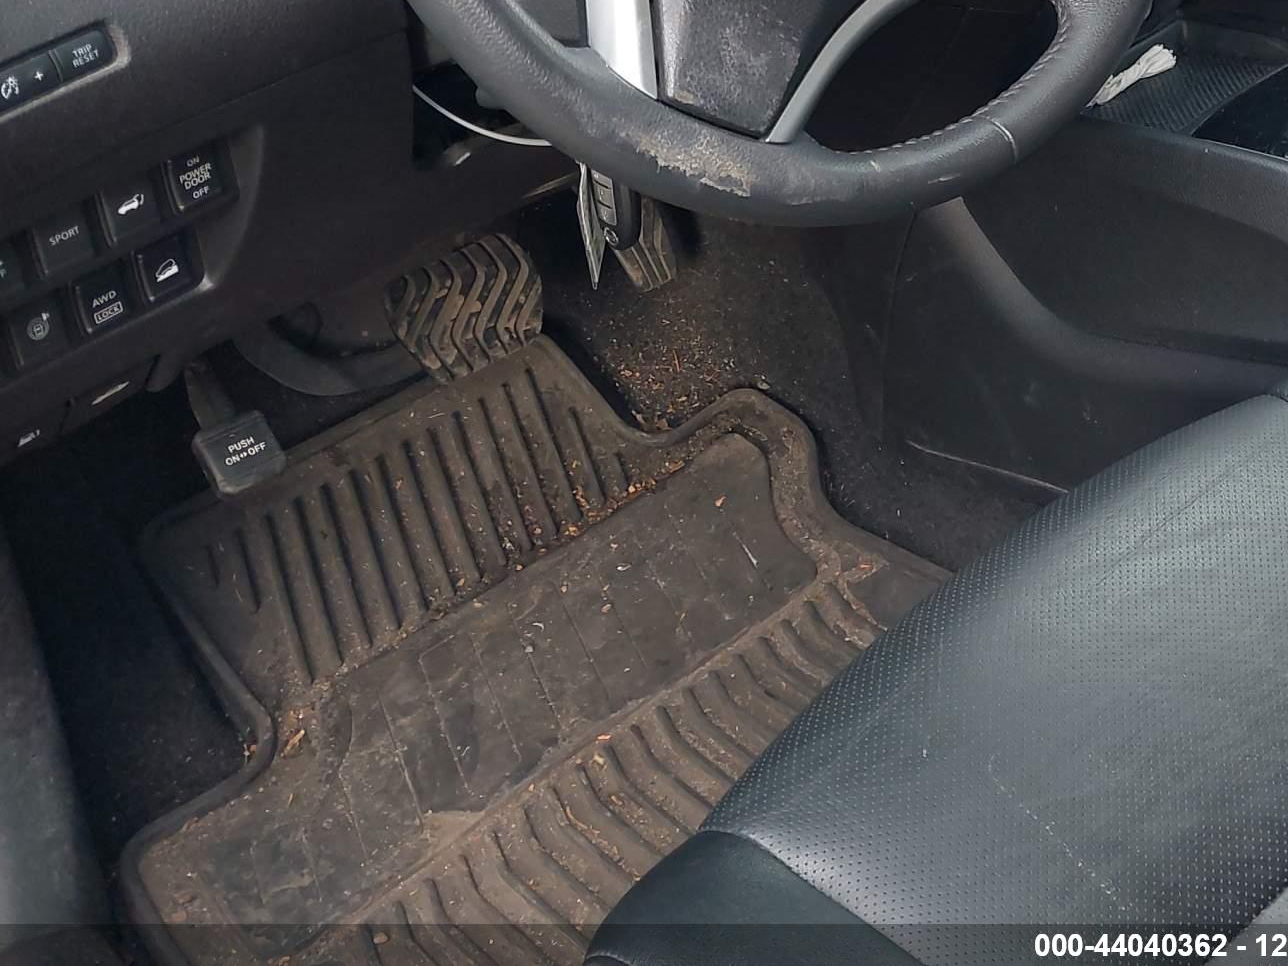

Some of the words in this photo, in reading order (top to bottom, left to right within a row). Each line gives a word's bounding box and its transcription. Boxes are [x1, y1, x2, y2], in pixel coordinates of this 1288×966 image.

[71, 43, 92, 58] TRIP
[71, 49, 100, 69] RESET
[186, 155, 200, 167] ON
[179, 162, 212, 185] POWER
[184, 171, 211, 191] DOOR
[192, 185, 210, 199] OFF
[48, 225, 80, 246] SPORT
[92, 290, 117, 309] AWD
[96, 304, 120, 322] LOCK
[227, 436, 255, 454] PUSH
